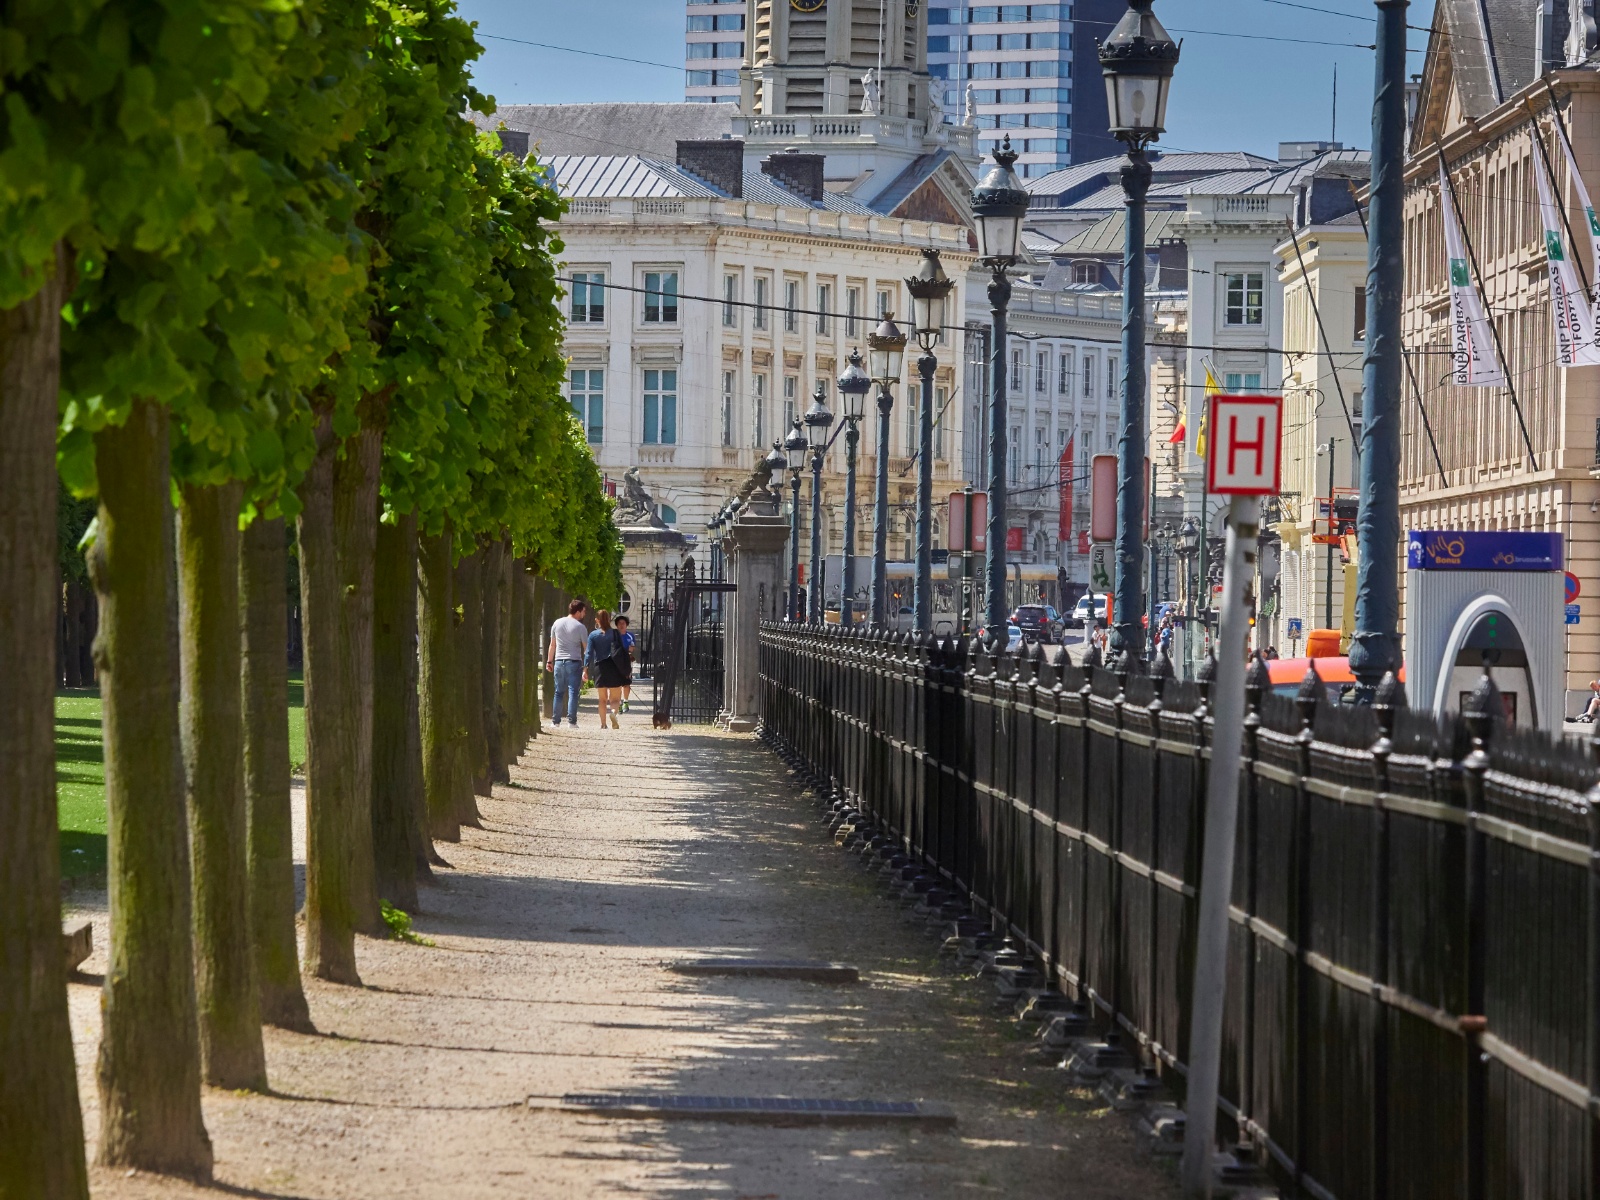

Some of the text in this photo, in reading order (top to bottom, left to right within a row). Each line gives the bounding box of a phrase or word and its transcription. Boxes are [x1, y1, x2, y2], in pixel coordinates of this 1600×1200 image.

[1454, 291, 1468, 384] BNP PARIBAS
[1551, 266, 1571, 364] BNP PARIBAS
[1227, 415, 1266, 476] H
[1435, 556, 1461, 564] Bonus
